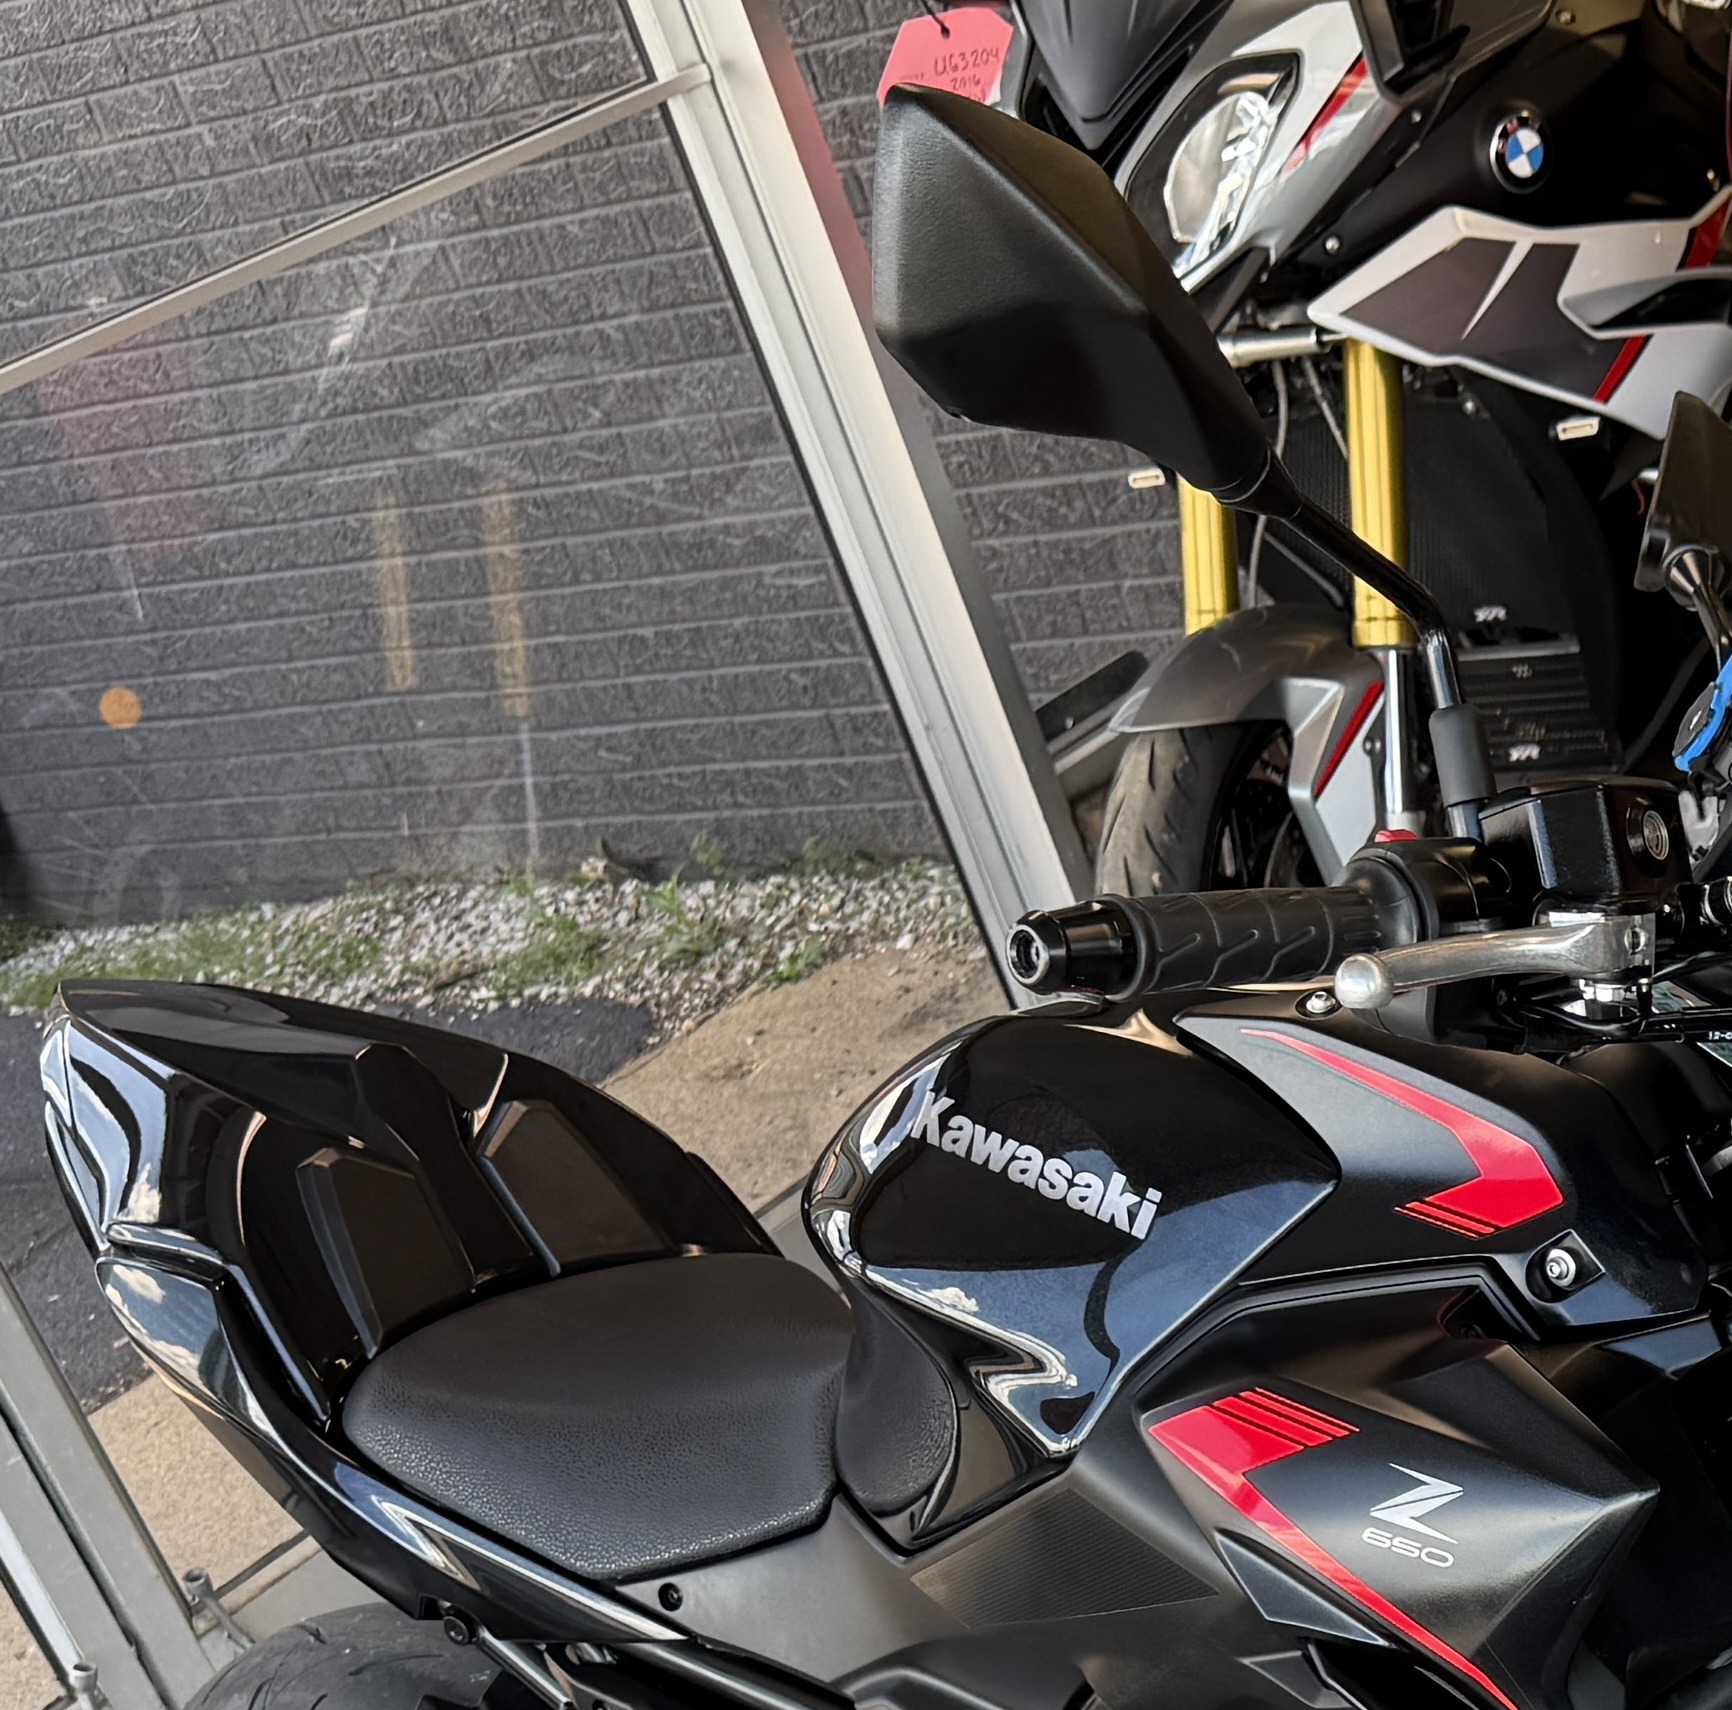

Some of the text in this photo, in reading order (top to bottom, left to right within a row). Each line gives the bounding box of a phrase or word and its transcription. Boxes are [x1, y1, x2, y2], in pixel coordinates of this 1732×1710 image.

[910, 1090, 1163, 1240] Kawasaki
[1369, 1462, 1464, 1545] Z
[1362, 1527, 1455, 1568] 650
